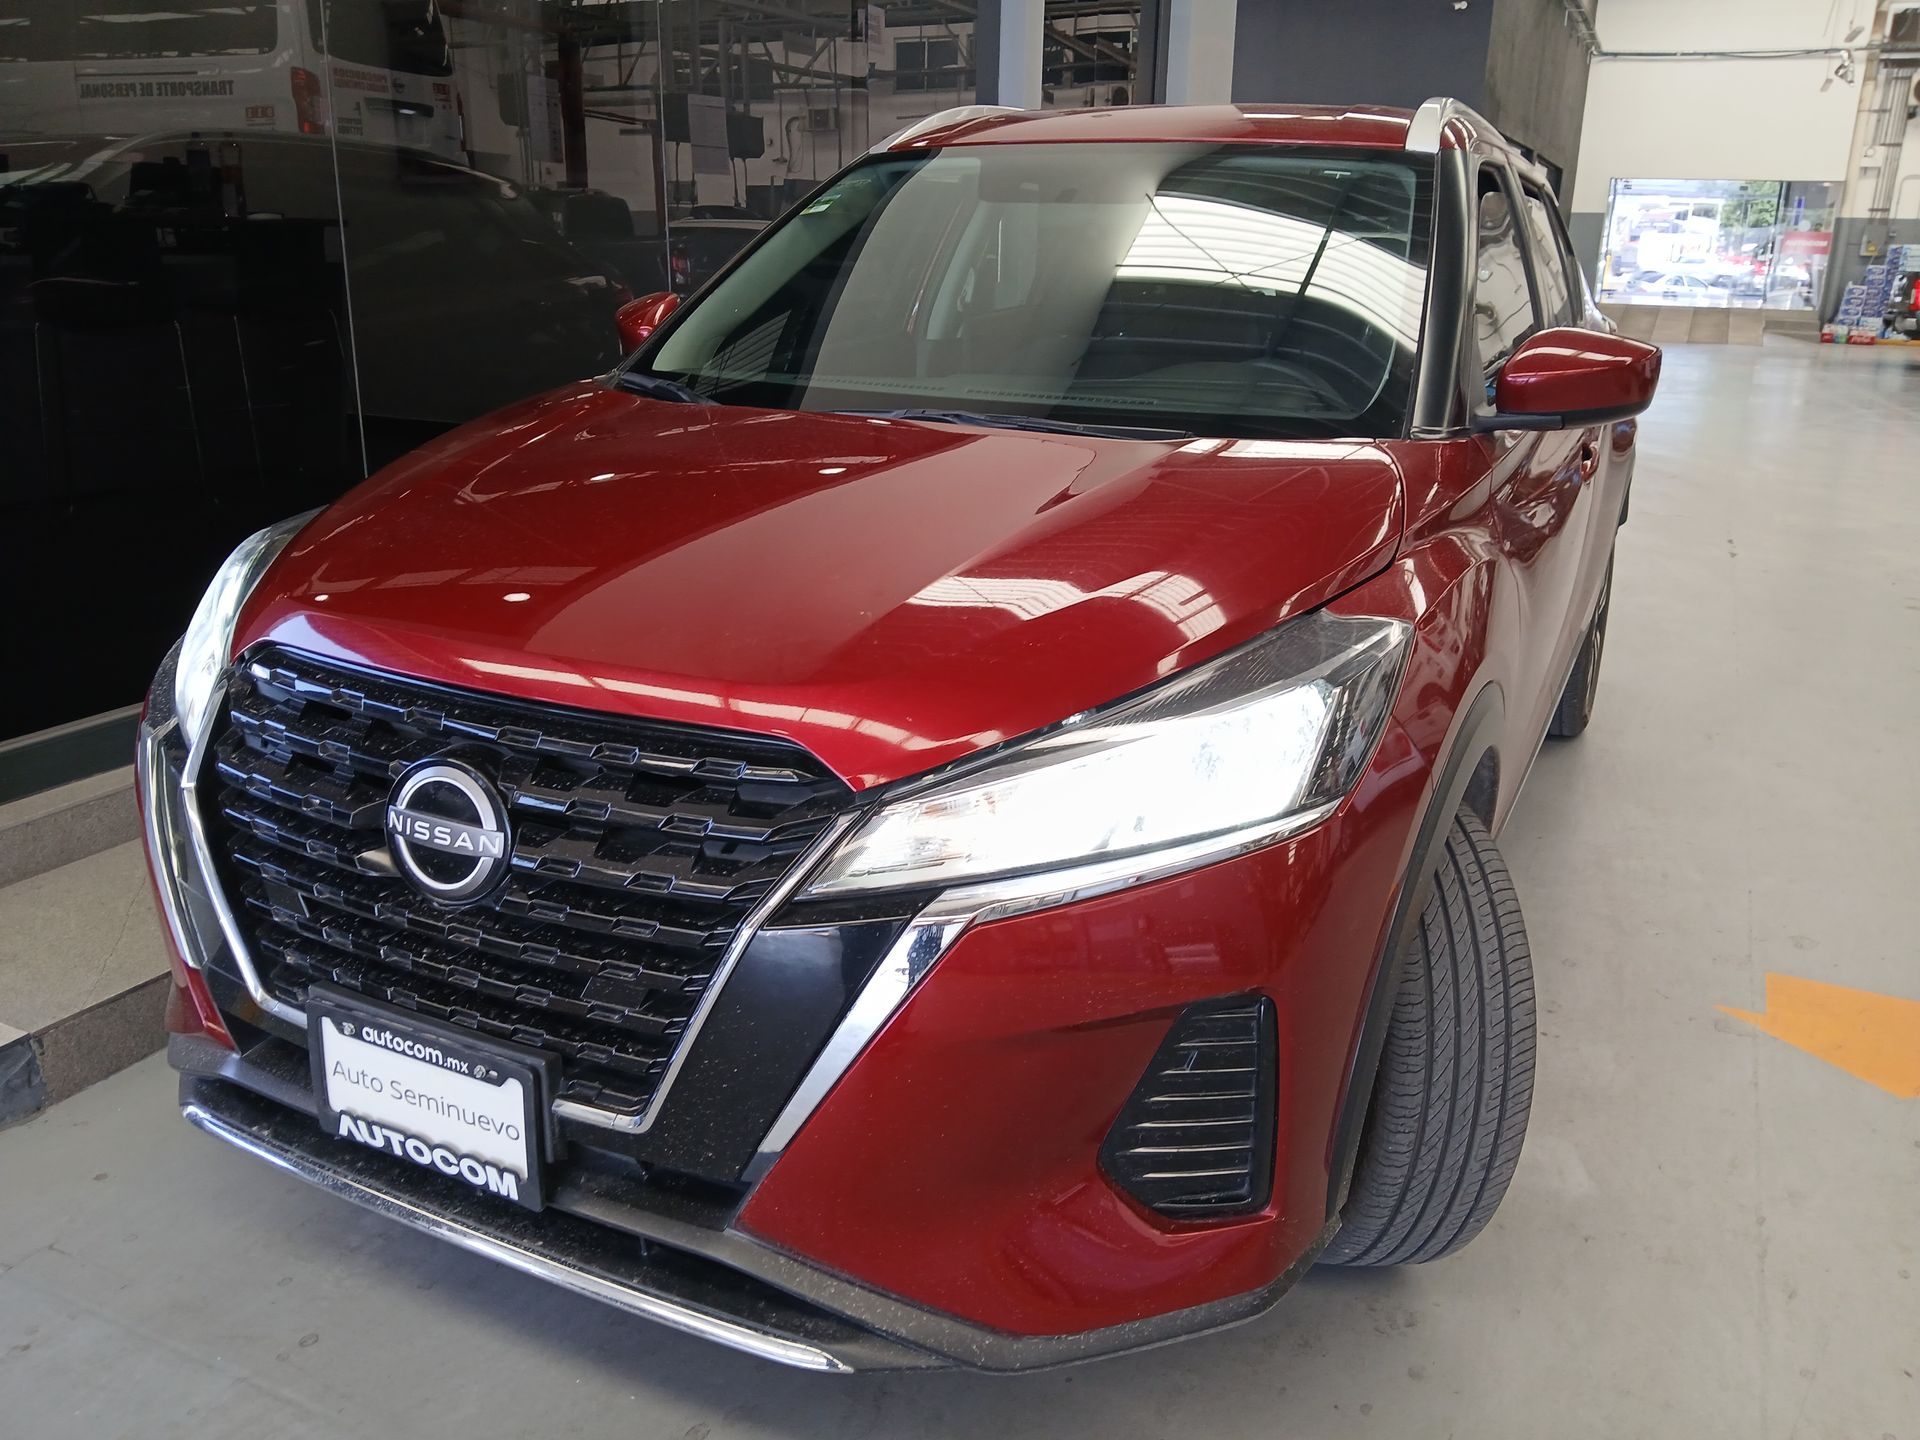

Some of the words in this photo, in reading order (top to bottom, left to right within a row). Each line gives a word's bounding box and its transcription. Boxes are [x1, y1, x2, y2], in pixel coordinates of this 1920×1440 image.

[389, 811, 500, 854] NISSAN
[362, 1025, 469, 1074] autocom.mx
[332, 1060, 384, 1093] Auto
[390, 1079, 520, 1141] Seminuevo
[338, 1114, 519, 1200] AUTOCOM
